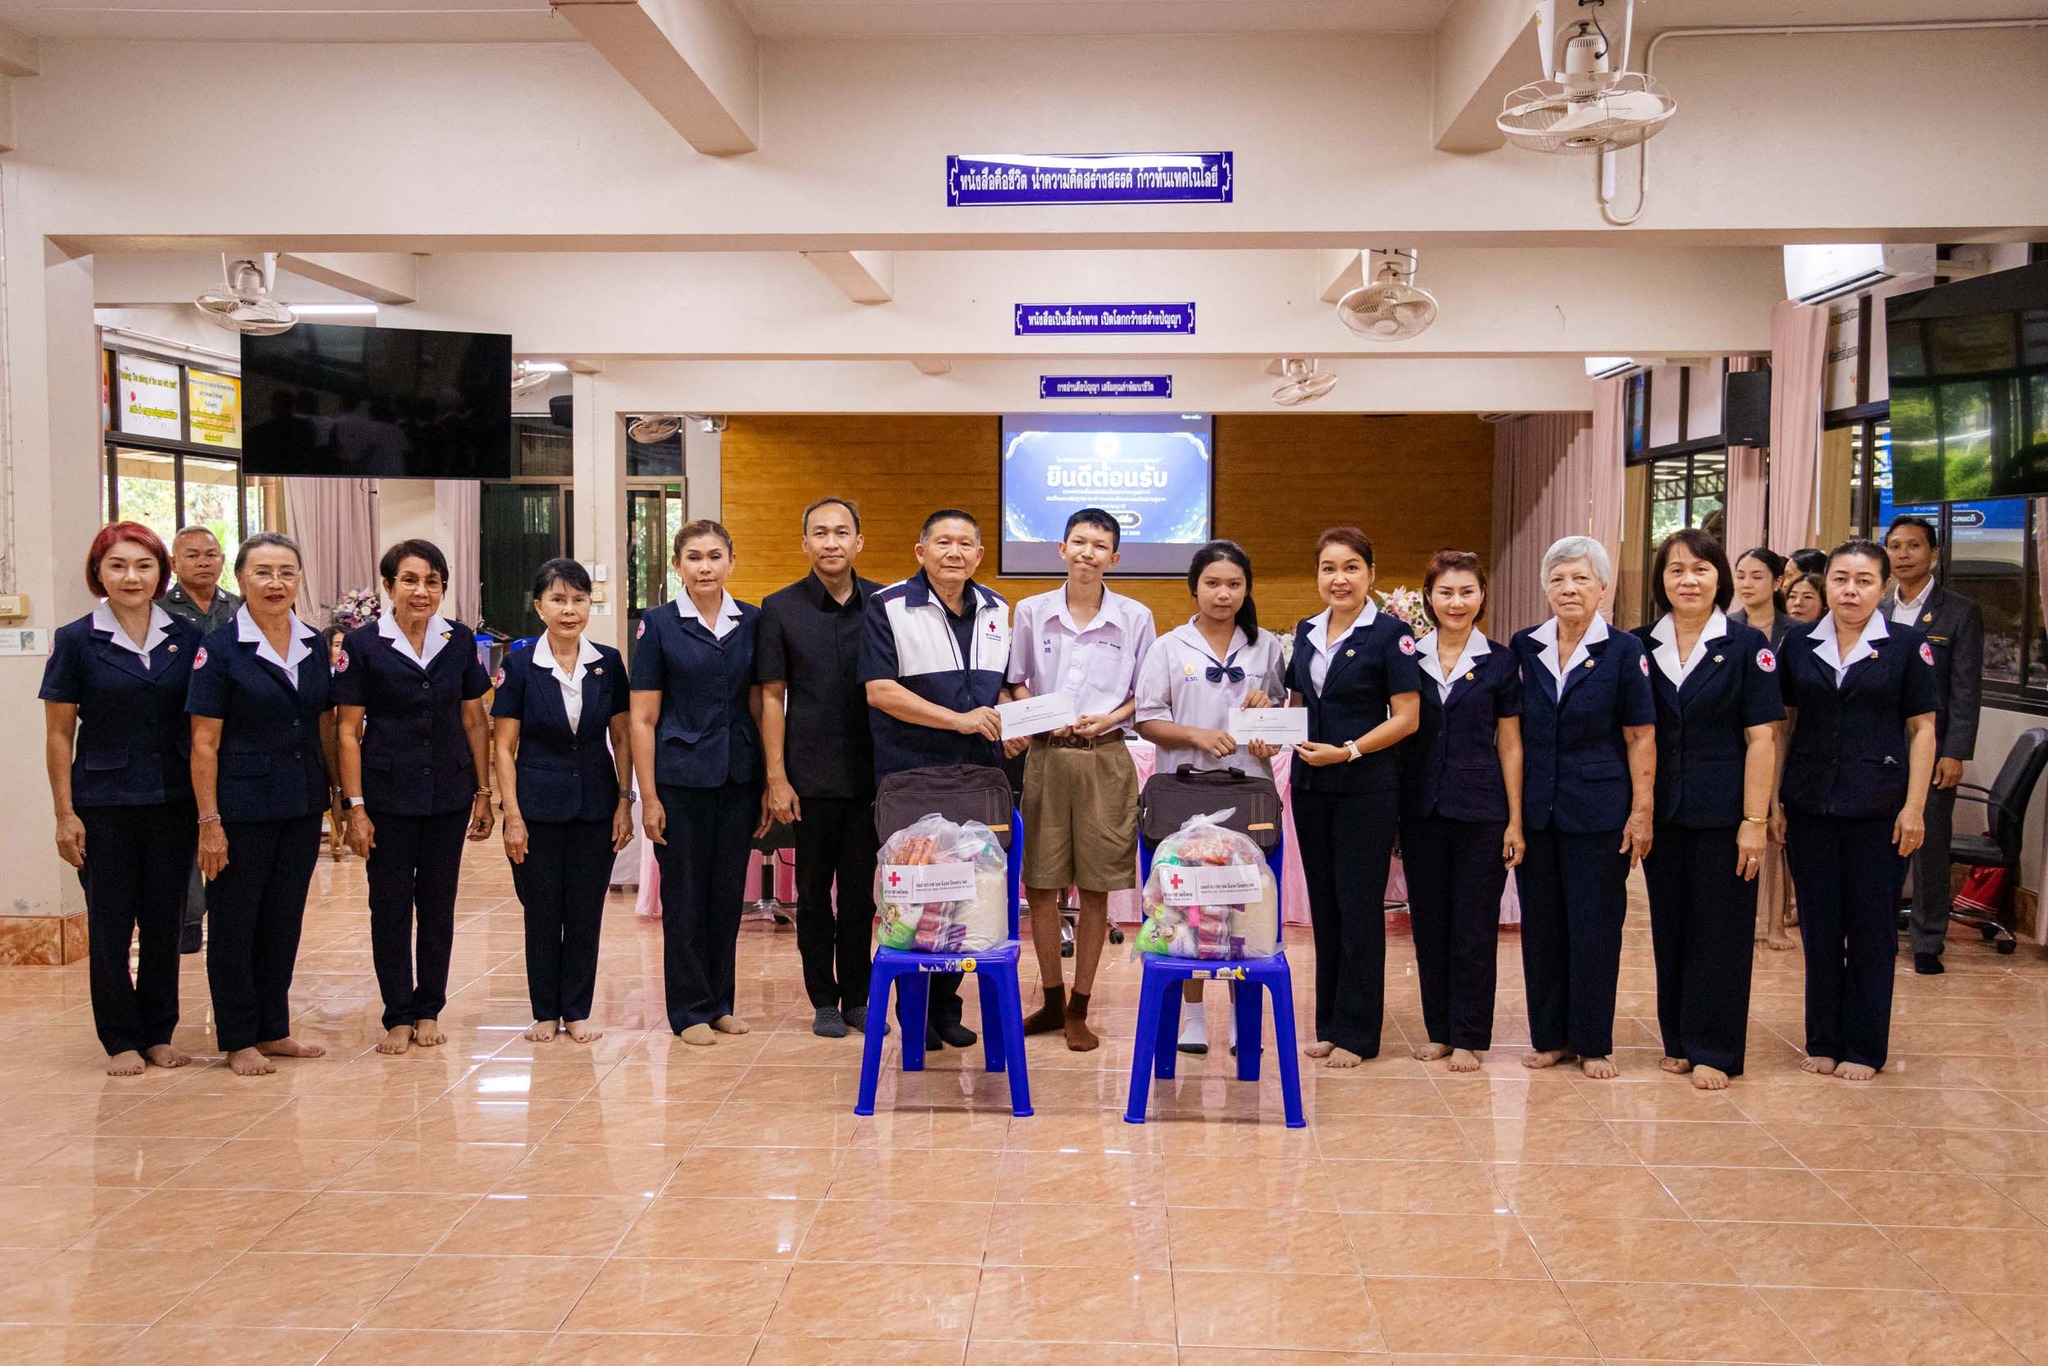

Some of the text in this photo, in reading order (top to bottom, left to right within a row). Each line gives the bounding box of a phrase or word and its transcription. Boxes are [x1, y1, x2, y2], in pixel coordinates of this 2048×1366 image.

[960, 164, 1219, 191] หนังสือคือชีวิต นำความคิดสร้างสรรค์ ก้าวทันเทคโนโลยี
[1028, 307, 1182, 329] หนังสือเป็นสื่อนำทาง เปิดโลกกว้างสร้างปัญญา
[1047, 462, 1168, 489] ยินดีต้อนรับ
